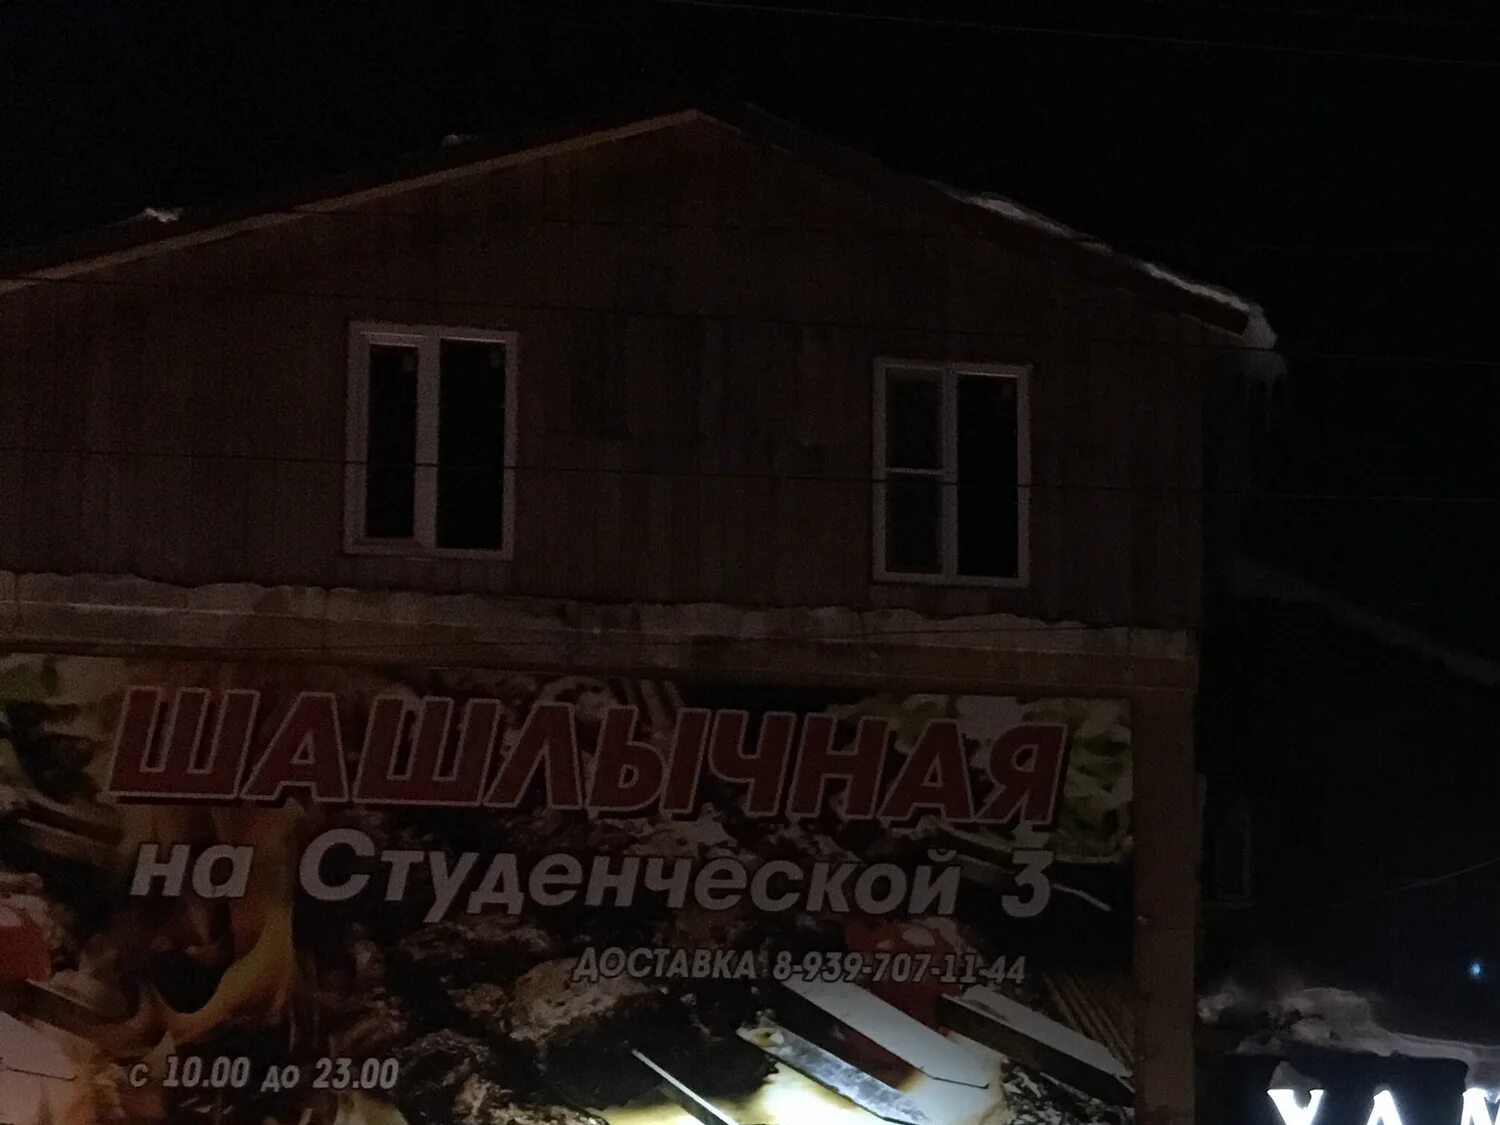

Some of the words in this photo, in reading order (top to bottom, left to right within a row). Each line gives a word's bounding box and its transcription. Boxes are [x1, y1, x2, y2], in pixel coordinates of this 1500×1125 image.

[104, 686, 1069, 825] ШАШЛЫЧНАЯ
[130, 843, 254, 898] на
[299, 828, 963, 923] Студенческой
[1001, 849, 1055, 918] 3
[572, 946, 757, 982] ДОСТАВКА
[773, 951, 1027, 985] 8-939-707-11-44
[128, 1063, 148, 1088] с
[162, 1056, 250, 1088] 10.00
[261, 1063, 300, 1092] до
[313, 1058, 400, 1090] 23.00
